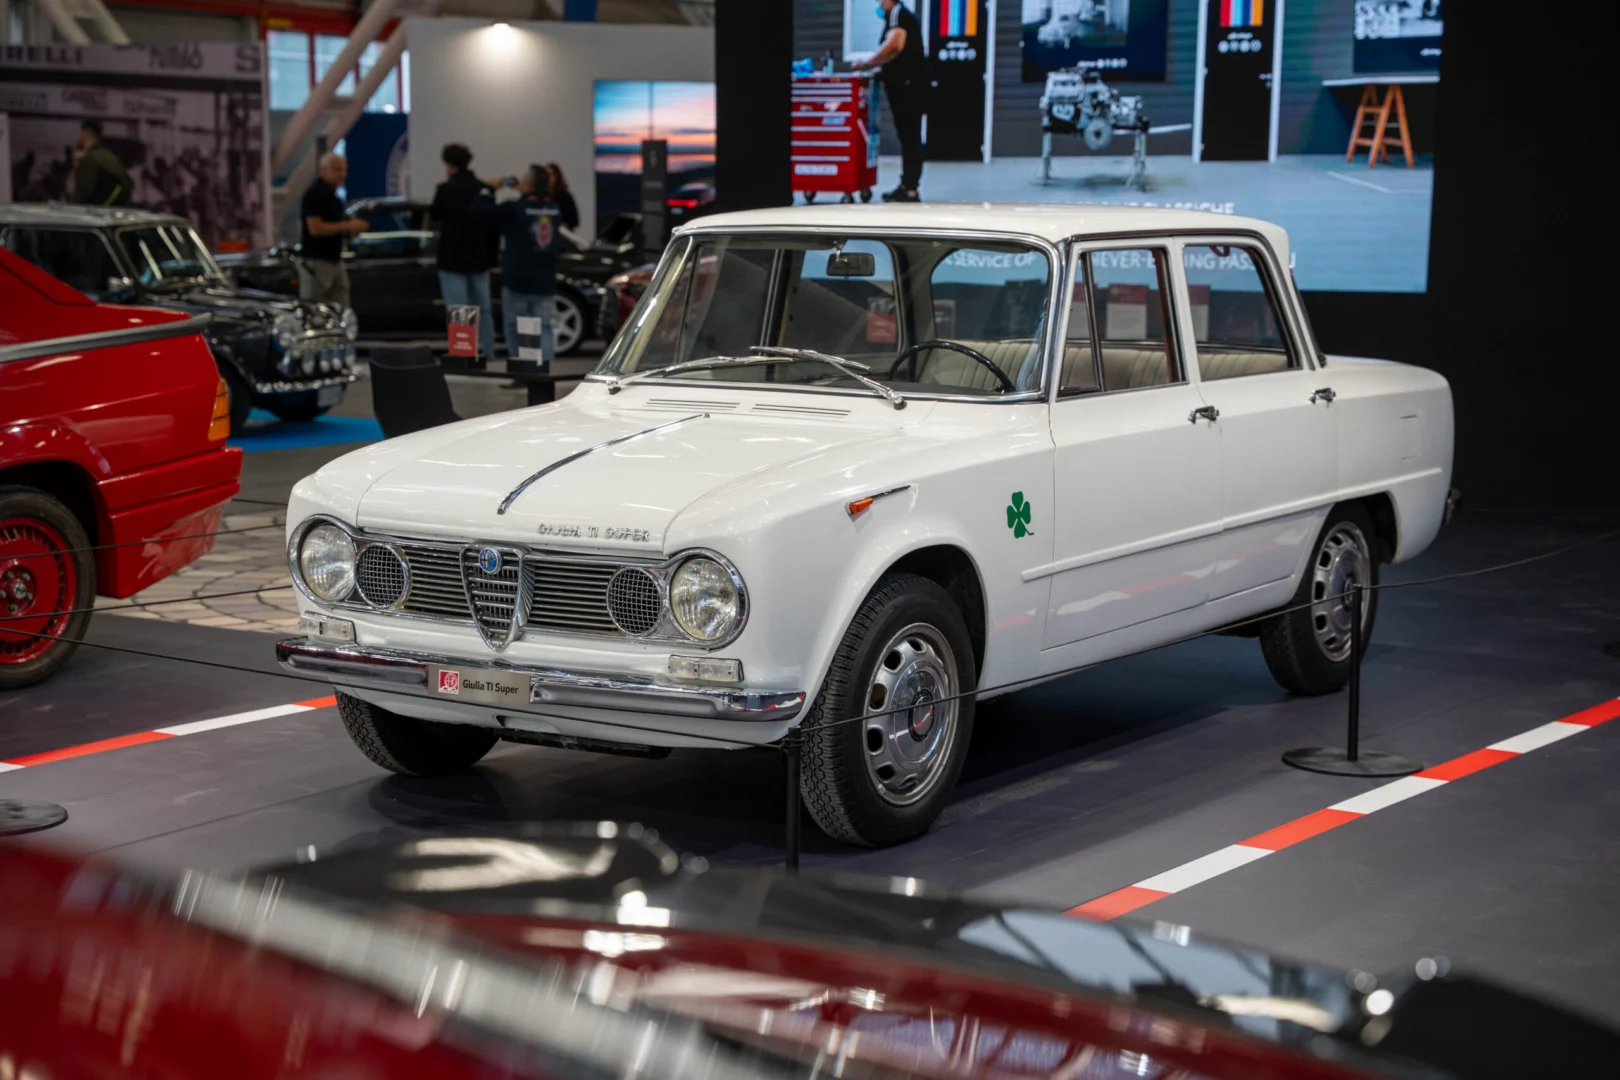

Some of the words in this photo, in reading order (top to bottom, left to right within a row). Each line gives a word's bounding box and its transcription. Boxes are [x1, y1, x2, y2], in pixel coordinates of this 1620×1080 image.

[951, 250, 1013, 268] SERVICE
[538, 523, 581, 538] GIULIA
[606, 527, 650, 543] SUPER
[463, 679, 485, 691] Giulia
[486, 681, 494, 691] TI
[495, 682, 518, 695] Super
